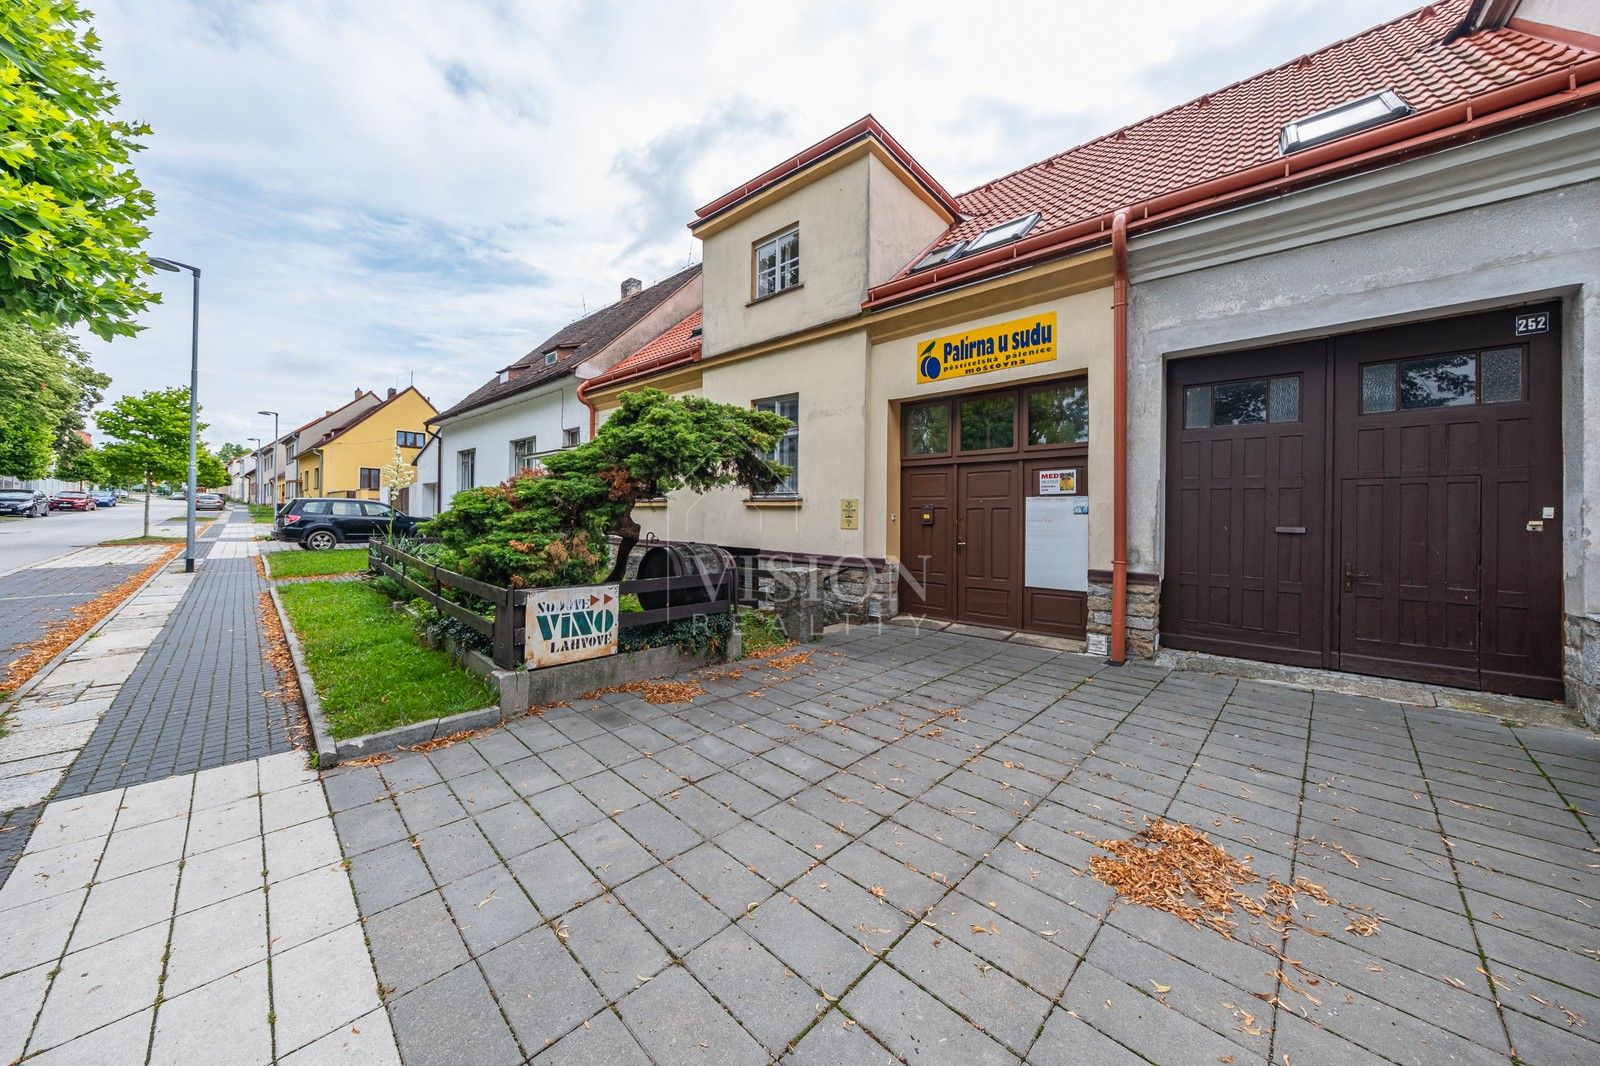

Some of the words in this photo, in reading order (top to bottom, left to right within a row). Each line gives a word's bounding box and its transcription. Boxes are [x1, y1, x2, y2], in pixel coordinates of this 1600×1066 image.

[1518, 316, 1546, 332] 252
[943, 336, 994, 364] Palírna
[997, 333, 1009, 353] u
[1012, 323, 1052, 350] sudu
